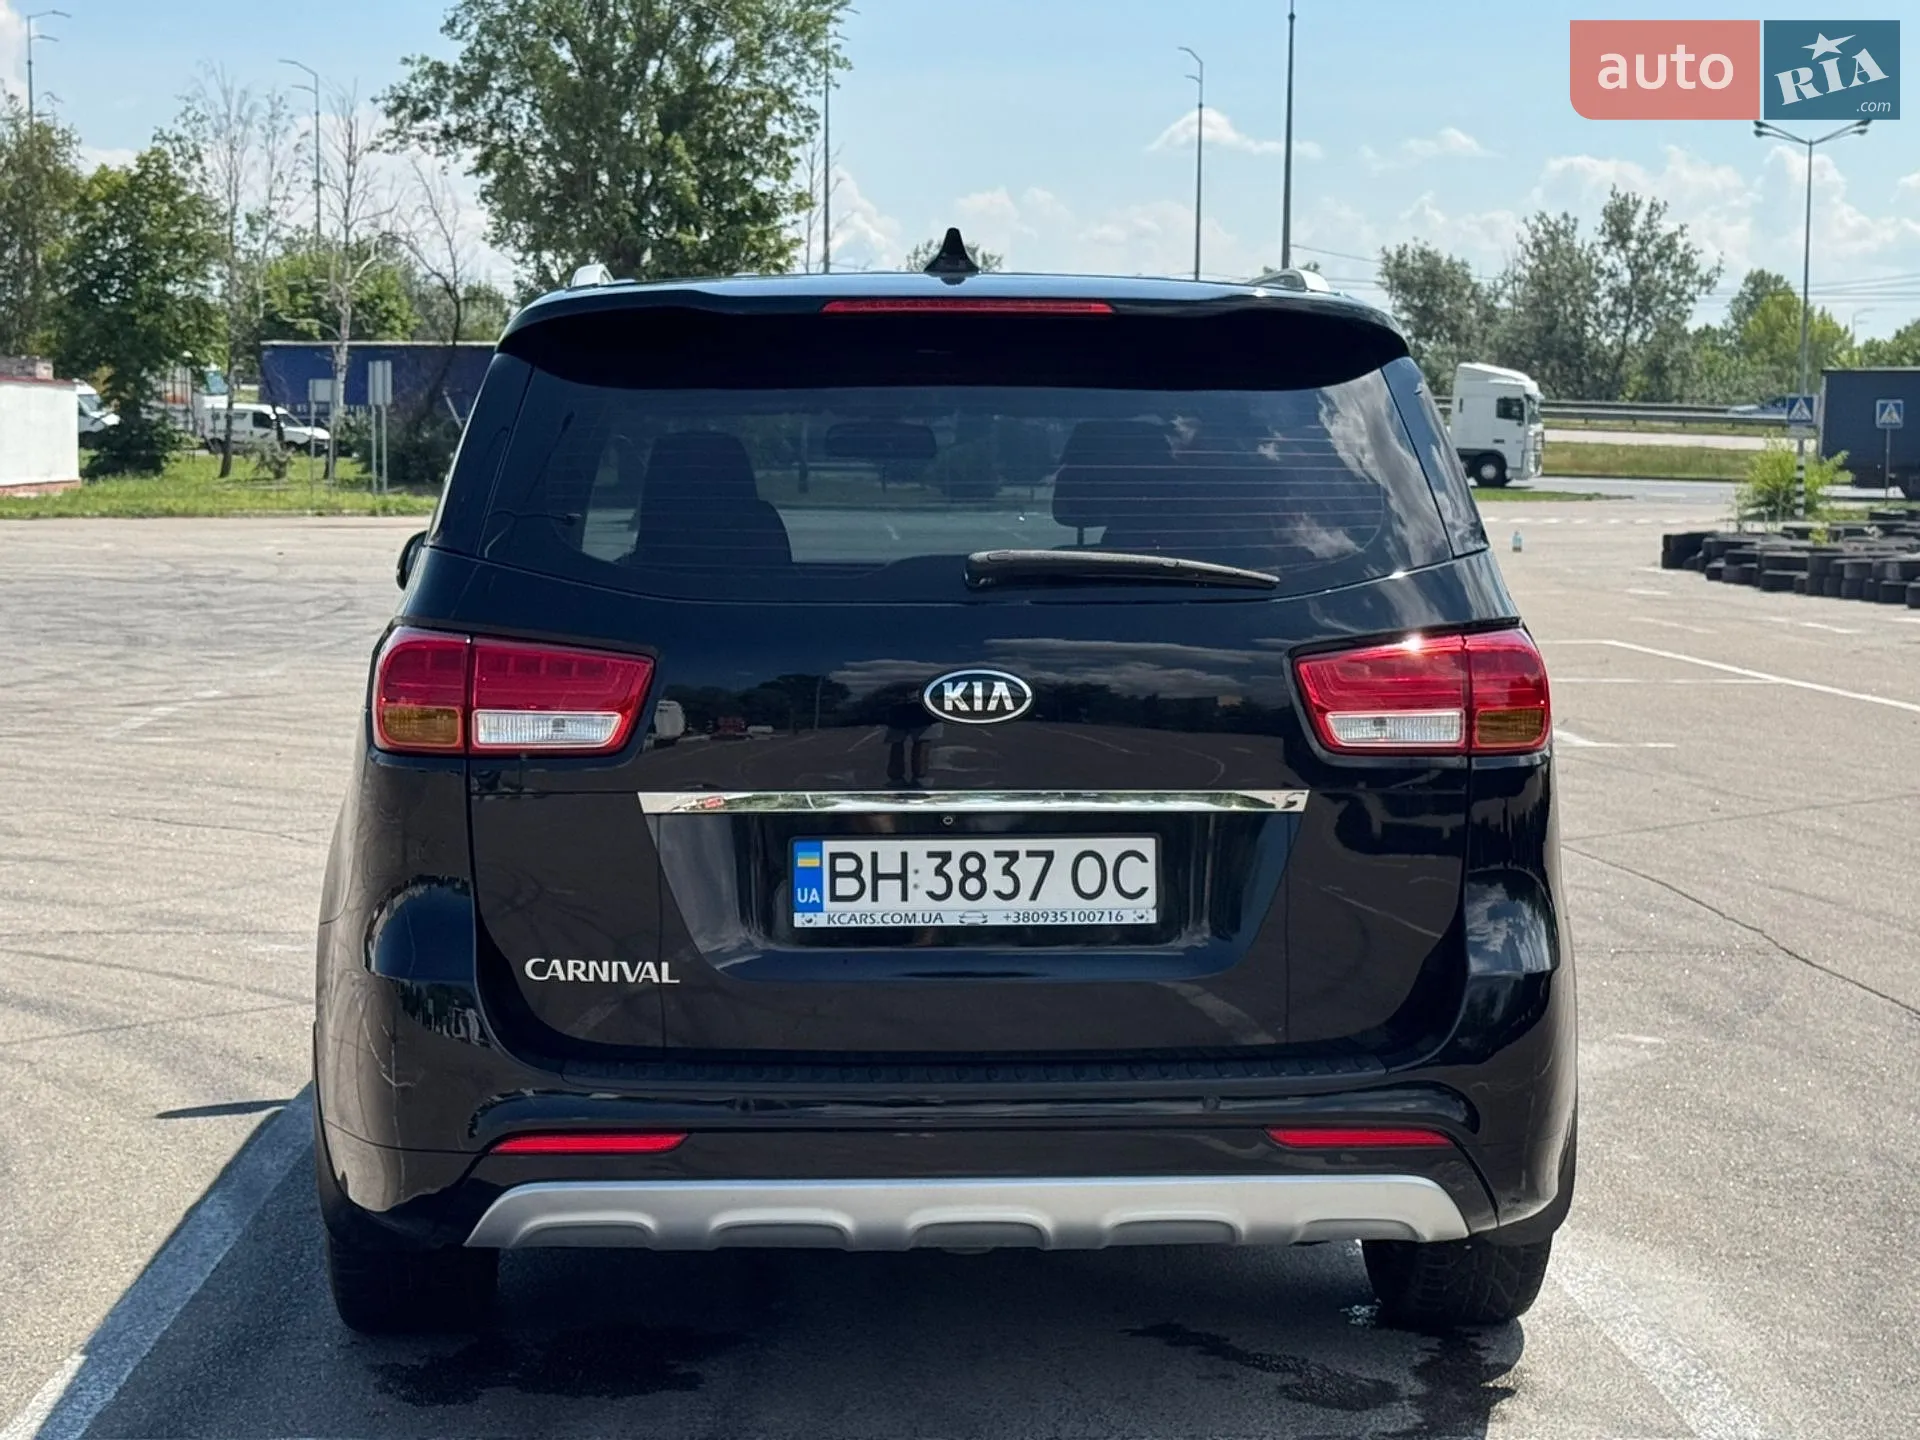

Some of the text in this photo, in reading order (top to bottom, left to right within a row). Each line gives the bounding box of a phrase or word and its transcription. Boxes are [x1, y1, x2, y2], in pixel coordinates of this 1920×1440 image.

[942, 681, 1015, 712] KIA
[828, 849, 1150, 903] BH 3837 OC
[797, 887, 821, 904] UA
[826, 910, 1124, 926] KCARS.COM.UA +380935100716
[524, 957, 681, 984] CARNIVAL
